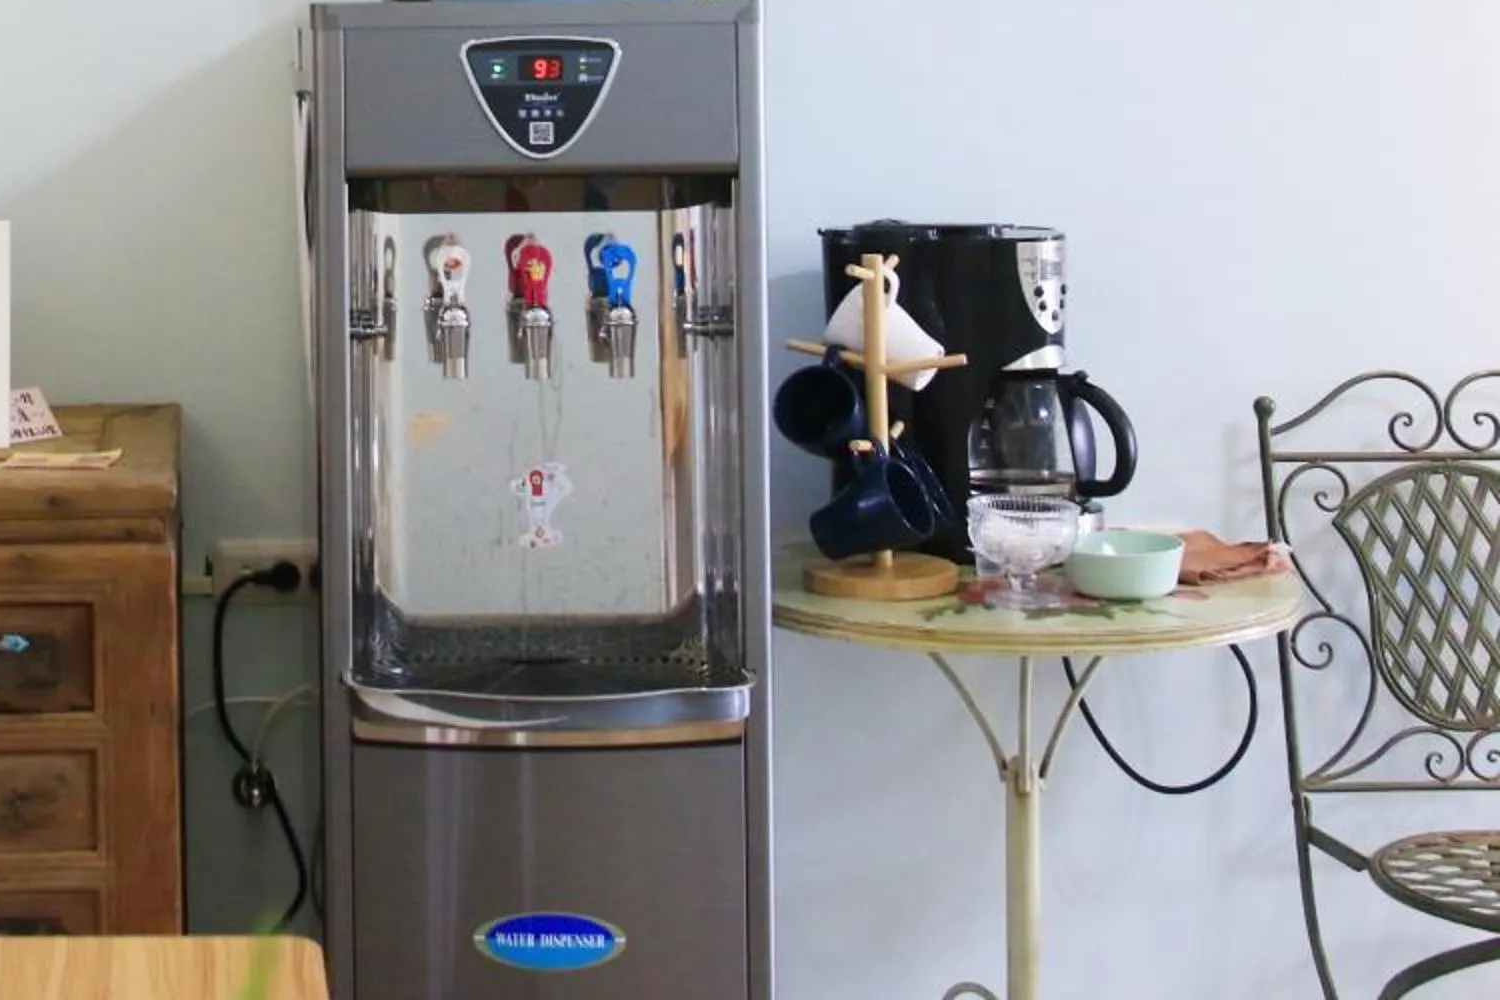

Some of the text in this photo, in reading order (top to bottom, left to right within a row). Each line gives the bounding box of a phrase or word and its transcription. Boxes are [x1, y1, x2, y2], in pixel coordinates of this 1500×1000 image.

[533, 58, 561, 79] 93
[495, 931, 605, 949] WATER DISPENSER
